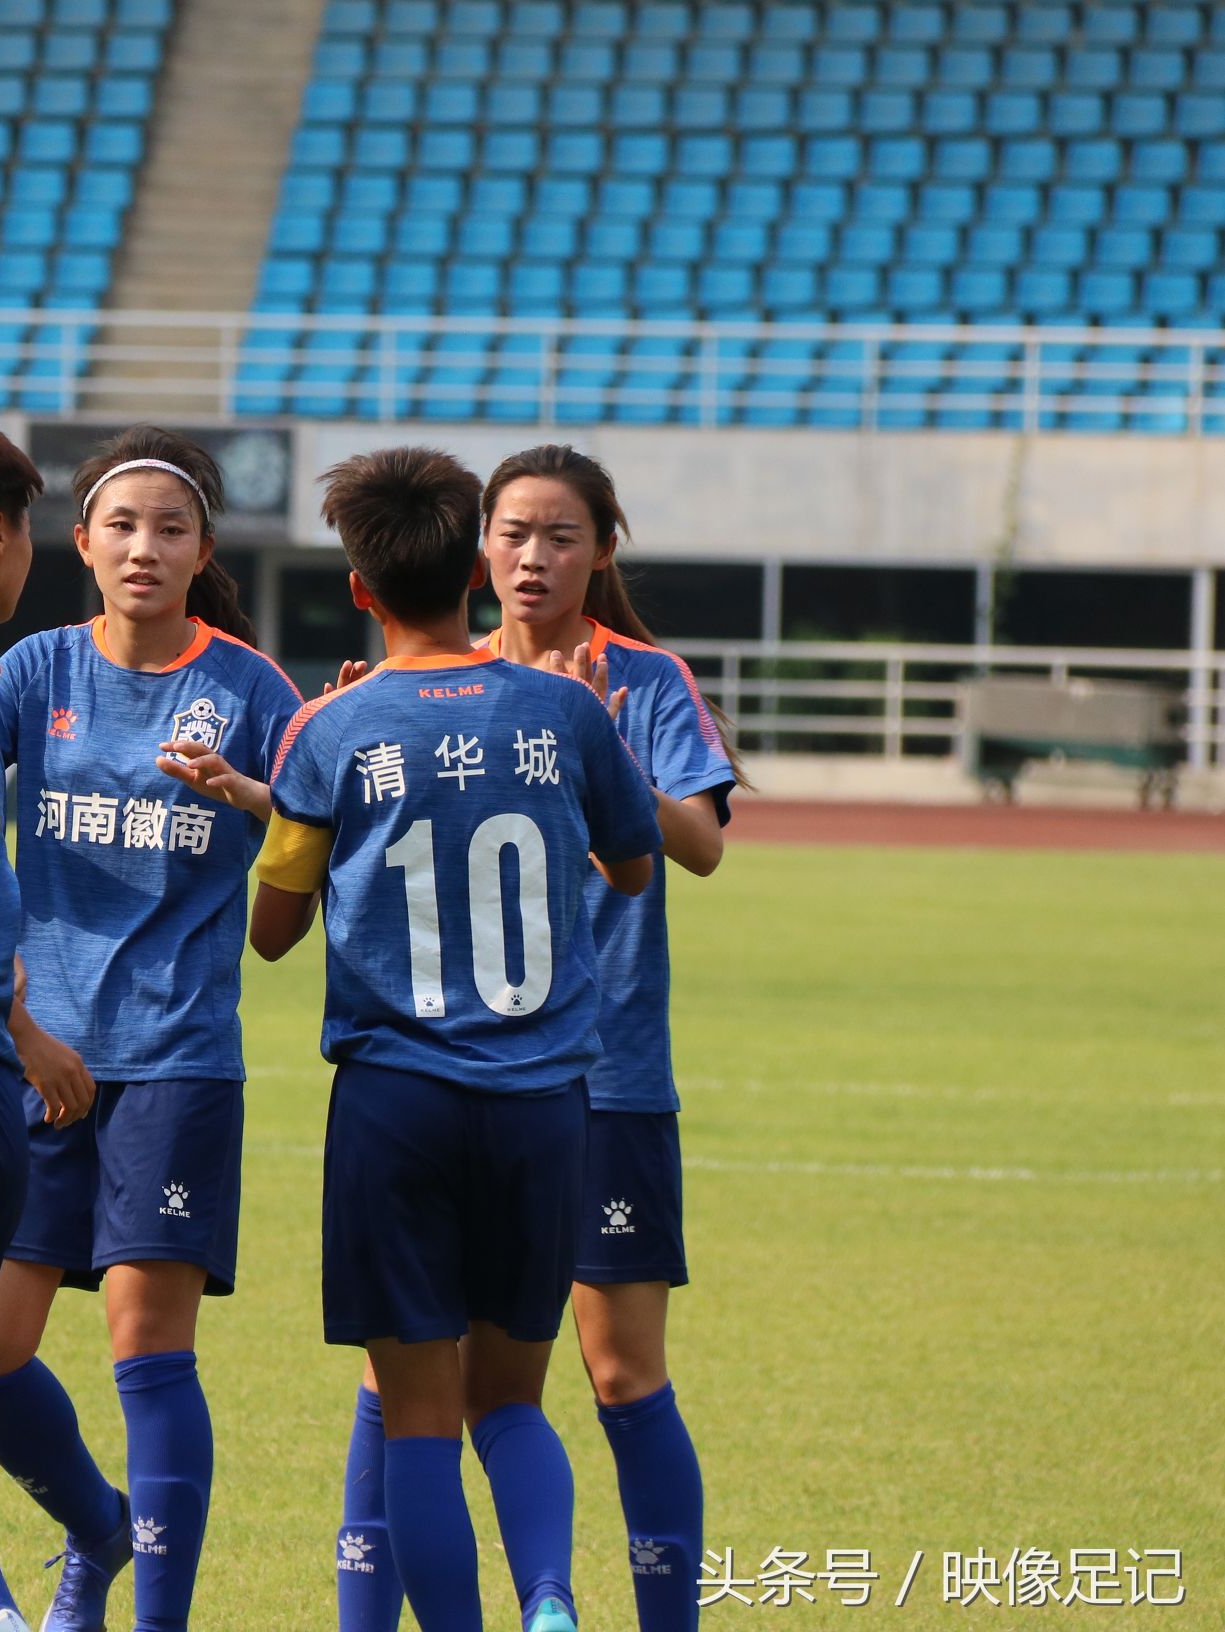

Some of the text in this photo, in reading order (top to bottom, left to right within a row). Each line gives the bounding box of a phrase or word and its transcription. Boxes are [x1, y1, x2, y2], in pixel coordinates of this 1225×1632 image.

[418, 684, 485, 698] KELME
[353, 729, 559, 804] 清华城
[35, 787, 216, 855] 河南徽商
[385, 812, 553, 1018] 10
[159, 1206, 191, 1219] KELME
[600, 1225, 636, 1235] KELME
[336, 1559, 375, 1574] KELME
